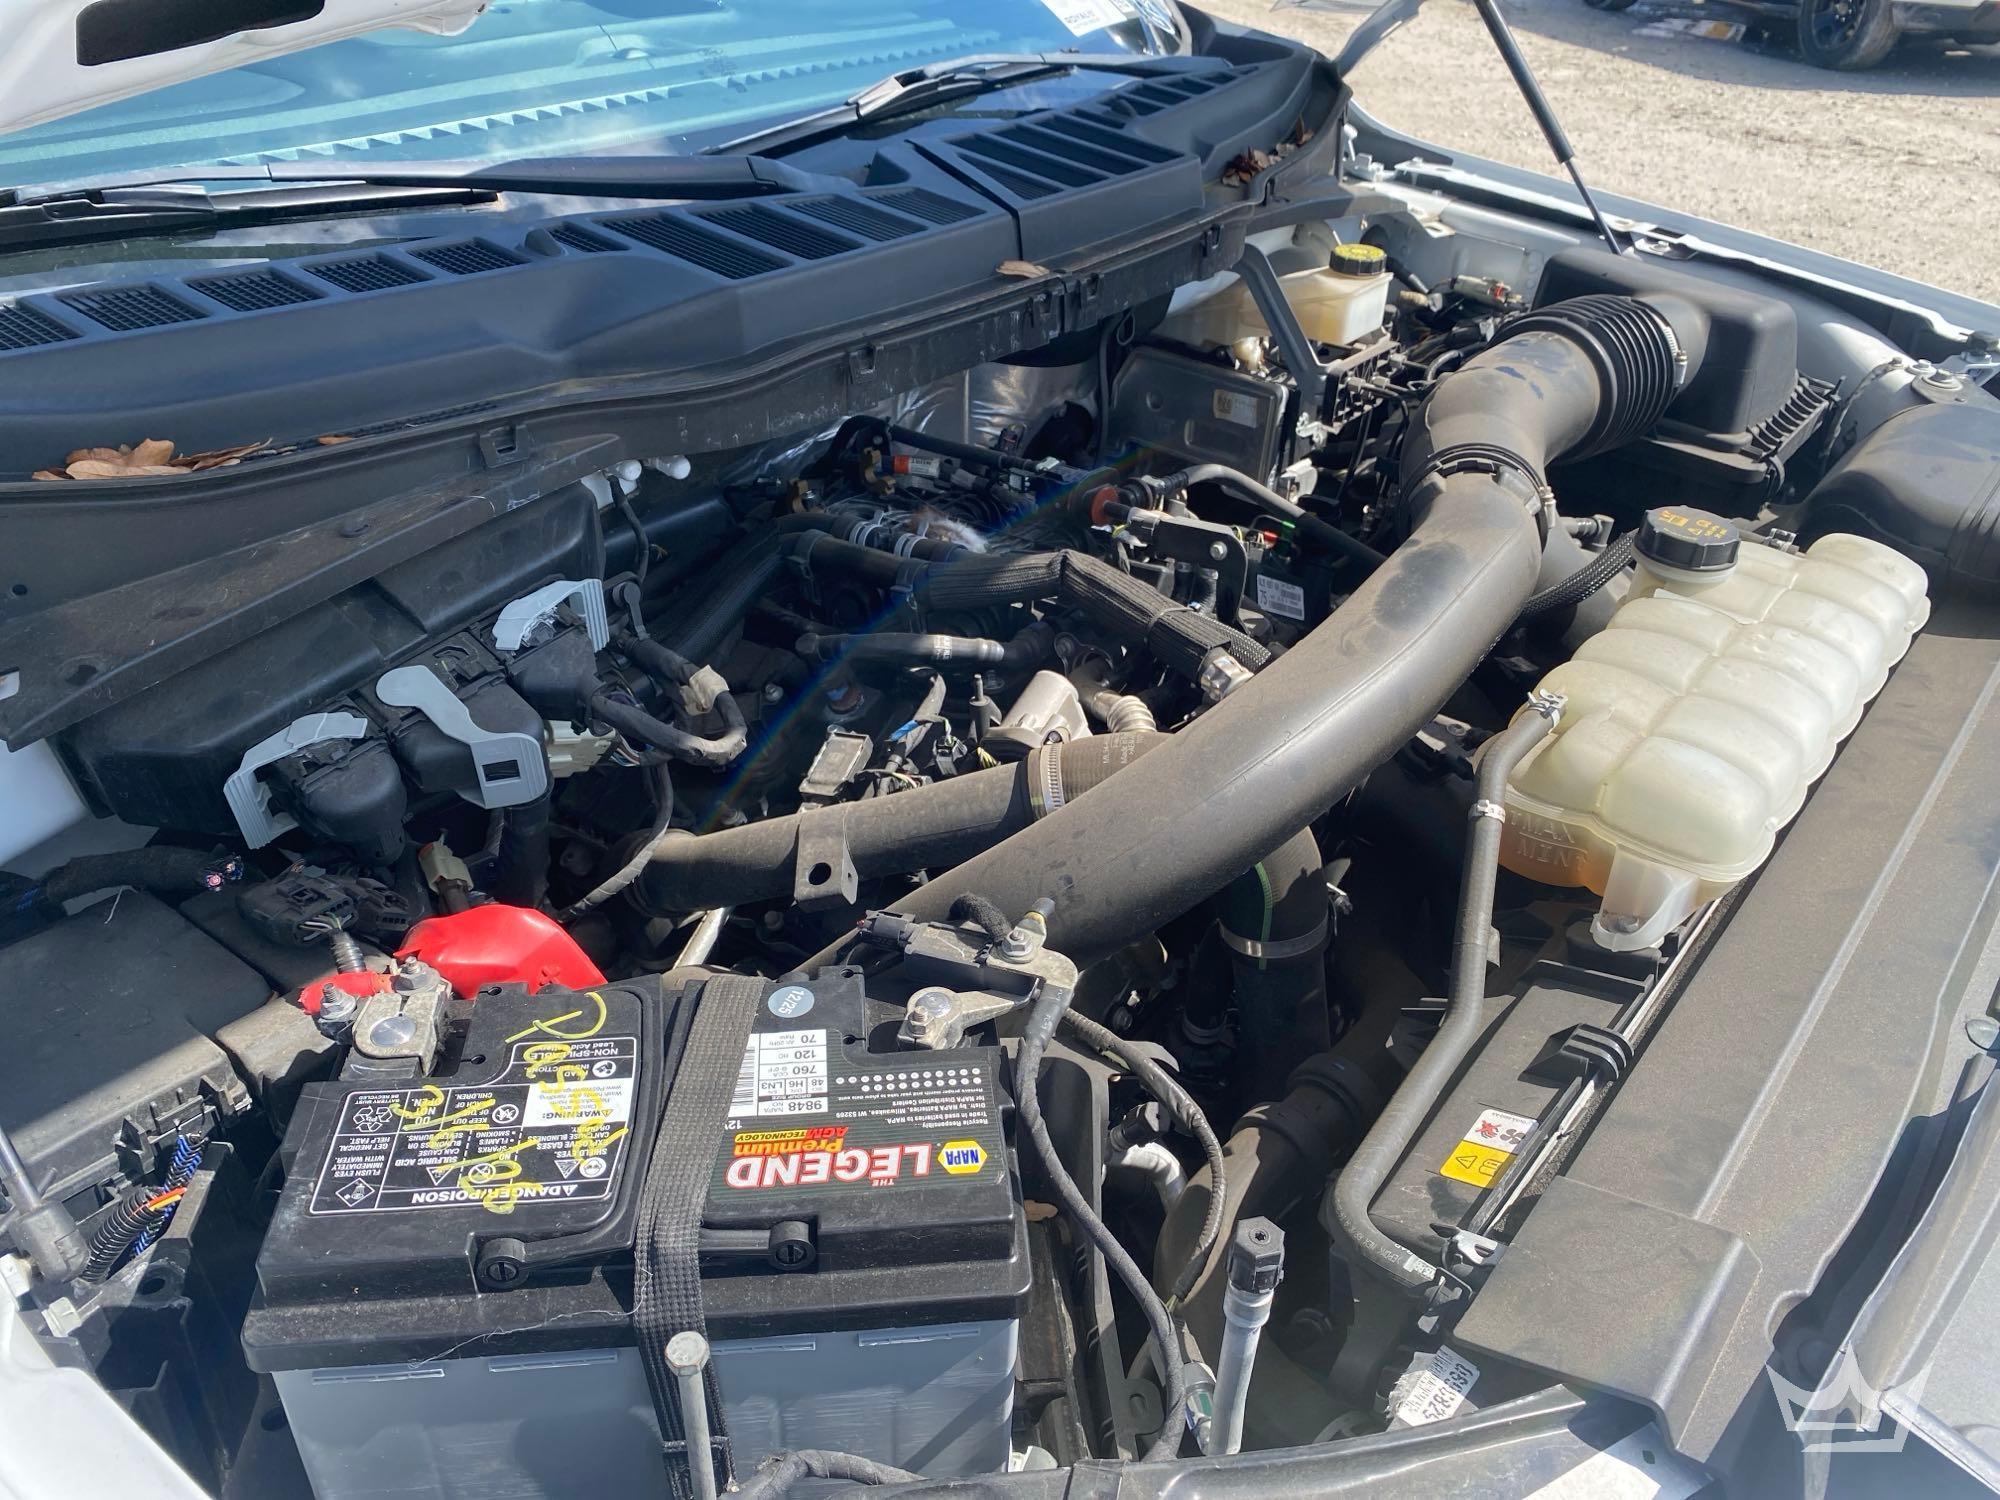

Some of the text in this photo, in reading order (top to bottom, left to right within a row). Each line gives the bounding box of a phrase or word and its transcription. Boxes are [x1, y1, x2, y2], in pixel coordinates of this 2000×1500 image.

[778, 990, 805, 1014] 12/25
[800, 1034, 816, 1043] 70
[794, 1050, 816, 1059] 120
[792, 1066, 816, 1074] 760
[761, 1082, 782, 1090] LN3
[788, 1080, 804, 1088] H6
[810, 1078, 824, 1086] 48
[454, 1092, 492, 1100] CHILDREN.
[788, 1100, 822, 1112] 9848
[868, 1108, 906, 1116] Milwaukee,
[944, 1112, 960, 1120] used
[414, 1116, 430, 1124] DO
[914, 1114, 943, 1122] batteries
[962, 1118, 988, 1126] Recycle
[406, 1134, 434, 1142] BURNS.
[476, 1130, 510, 1138] SMOKING
[736, 1126, 848, 1142] AGM TECHNOLOGY
[371, 1136, 390, 1144] HELP
[479, 1137, 509, 1146] FLAMES
[338, 1144, 372, 1152] MEDICAL
[408, 1142, 418, 1150] OR
[478, 1145, 507, 1153] SPARKS
[536, 1142, 563, 1150] GASES
[733, 1138, 844, 1158] Premium
[444, 1148, 460, 1156] CAN
[499, 1152, 511, 1160] NO
[334, 1156, 362, 1164] WATER.
[394, 1156, 458, 1166] SULFURIC ACID
[945, 1149, 979, 1165] NAPA
[331, 1162, 383, 1170] IMMEDIATELY
[724, 1142, 931, 1189] LEGEND
[334, 1170, 354, 1178] EYES
[871, 1178, 894, 1186] THE
[411, 1185, 562, 1204] DANGER/POISON
